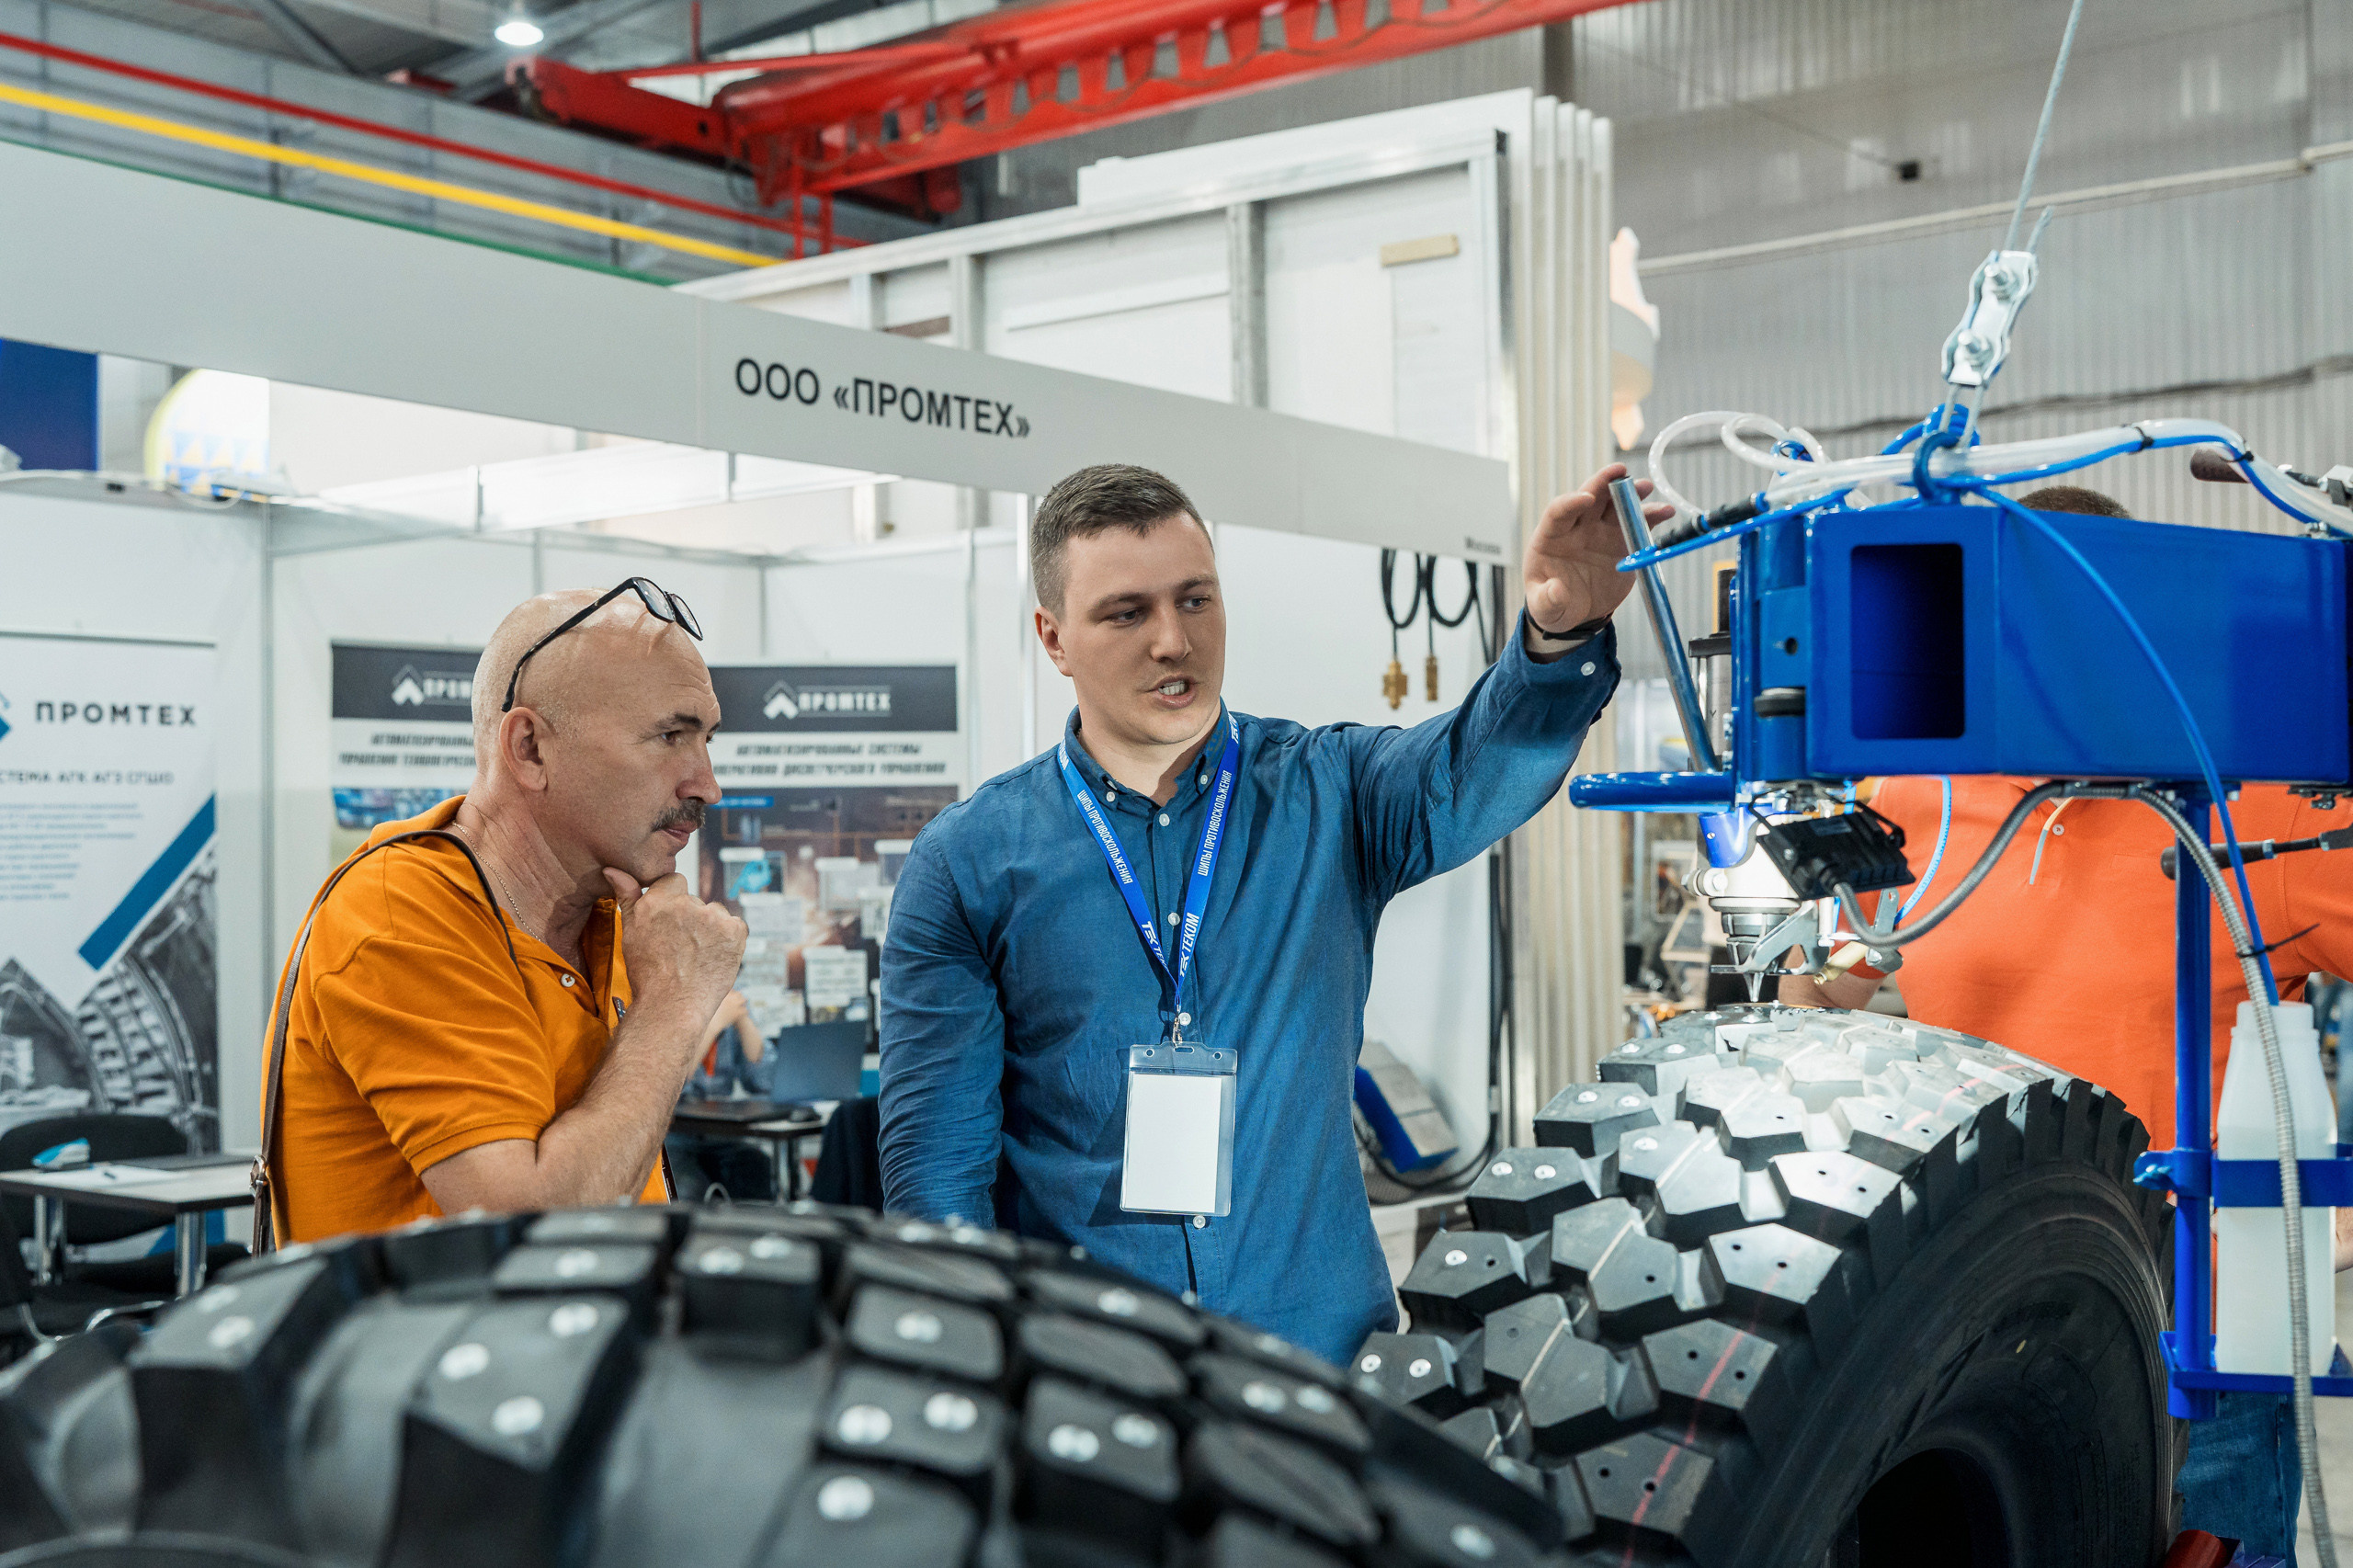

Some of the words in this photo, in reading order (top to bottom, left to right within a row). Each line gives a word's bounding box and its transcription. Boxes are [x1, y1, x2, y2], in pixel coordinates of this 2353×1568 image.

[735, 358, 820, 406] ООО
[833, 377, 1031, 438] «ПРОМТЕХ»
[36, 700, 196, 727] ПРОМТЕХ
[1076, 789, 1096, 812] ШИПЫ
[1087, 809, 1133, 884] ПРОТИВОСКОЛЬЖЕНИЯ
[1204, 769, 1233, 851] ПРОТИВОСКОЛЬЖЕНИЯ
[1198, 849, 1212, 877] ШИПЫ
[1182, 912, 1199, 953] ТЕКОМ
